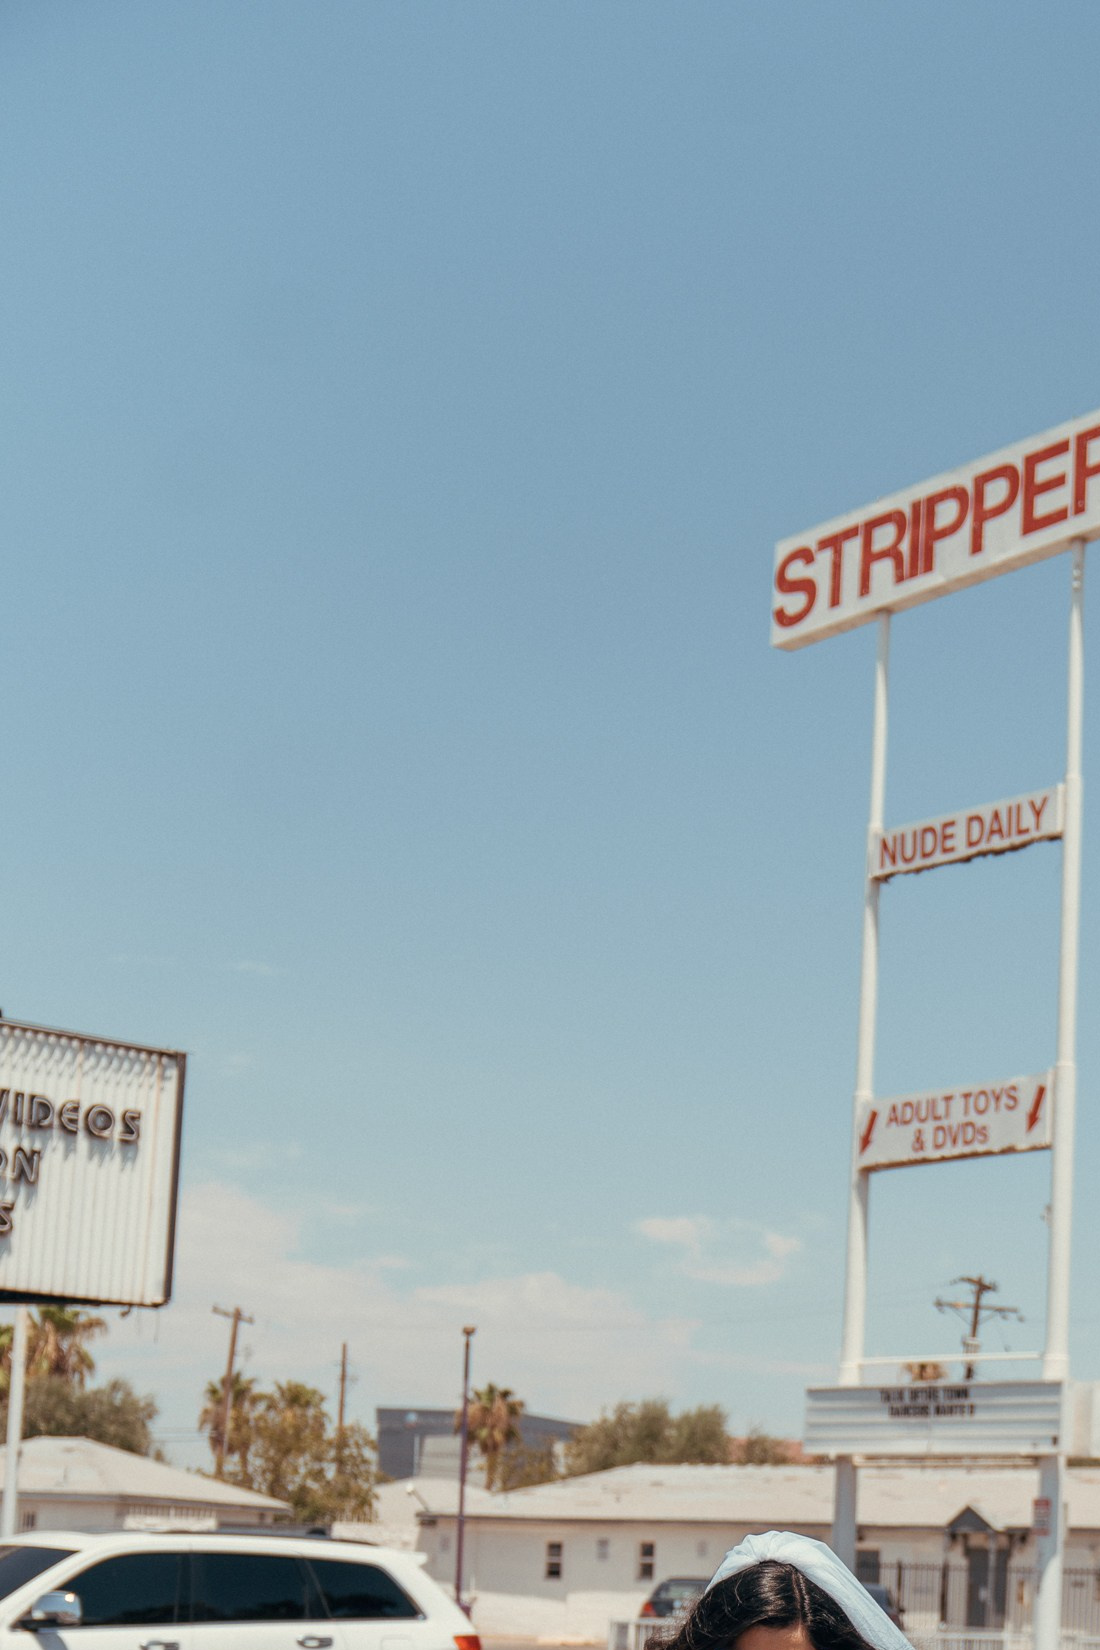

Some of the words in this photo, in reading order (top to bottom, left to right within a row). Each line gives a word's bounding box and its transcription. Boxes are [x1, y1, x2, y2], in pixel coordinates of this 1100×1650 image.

[879, 820, 956, 869] NUDE
[965, 797, 1049, 848] DAILY
[886, 1095, 953, 1126] ADULT
[962, 1085, 1019, 1117] TOYS
[911, 1129, 925, 1153] &
[933, 1121, 989, 1150] DVDs
[0, 1148, 40, 1184] N
